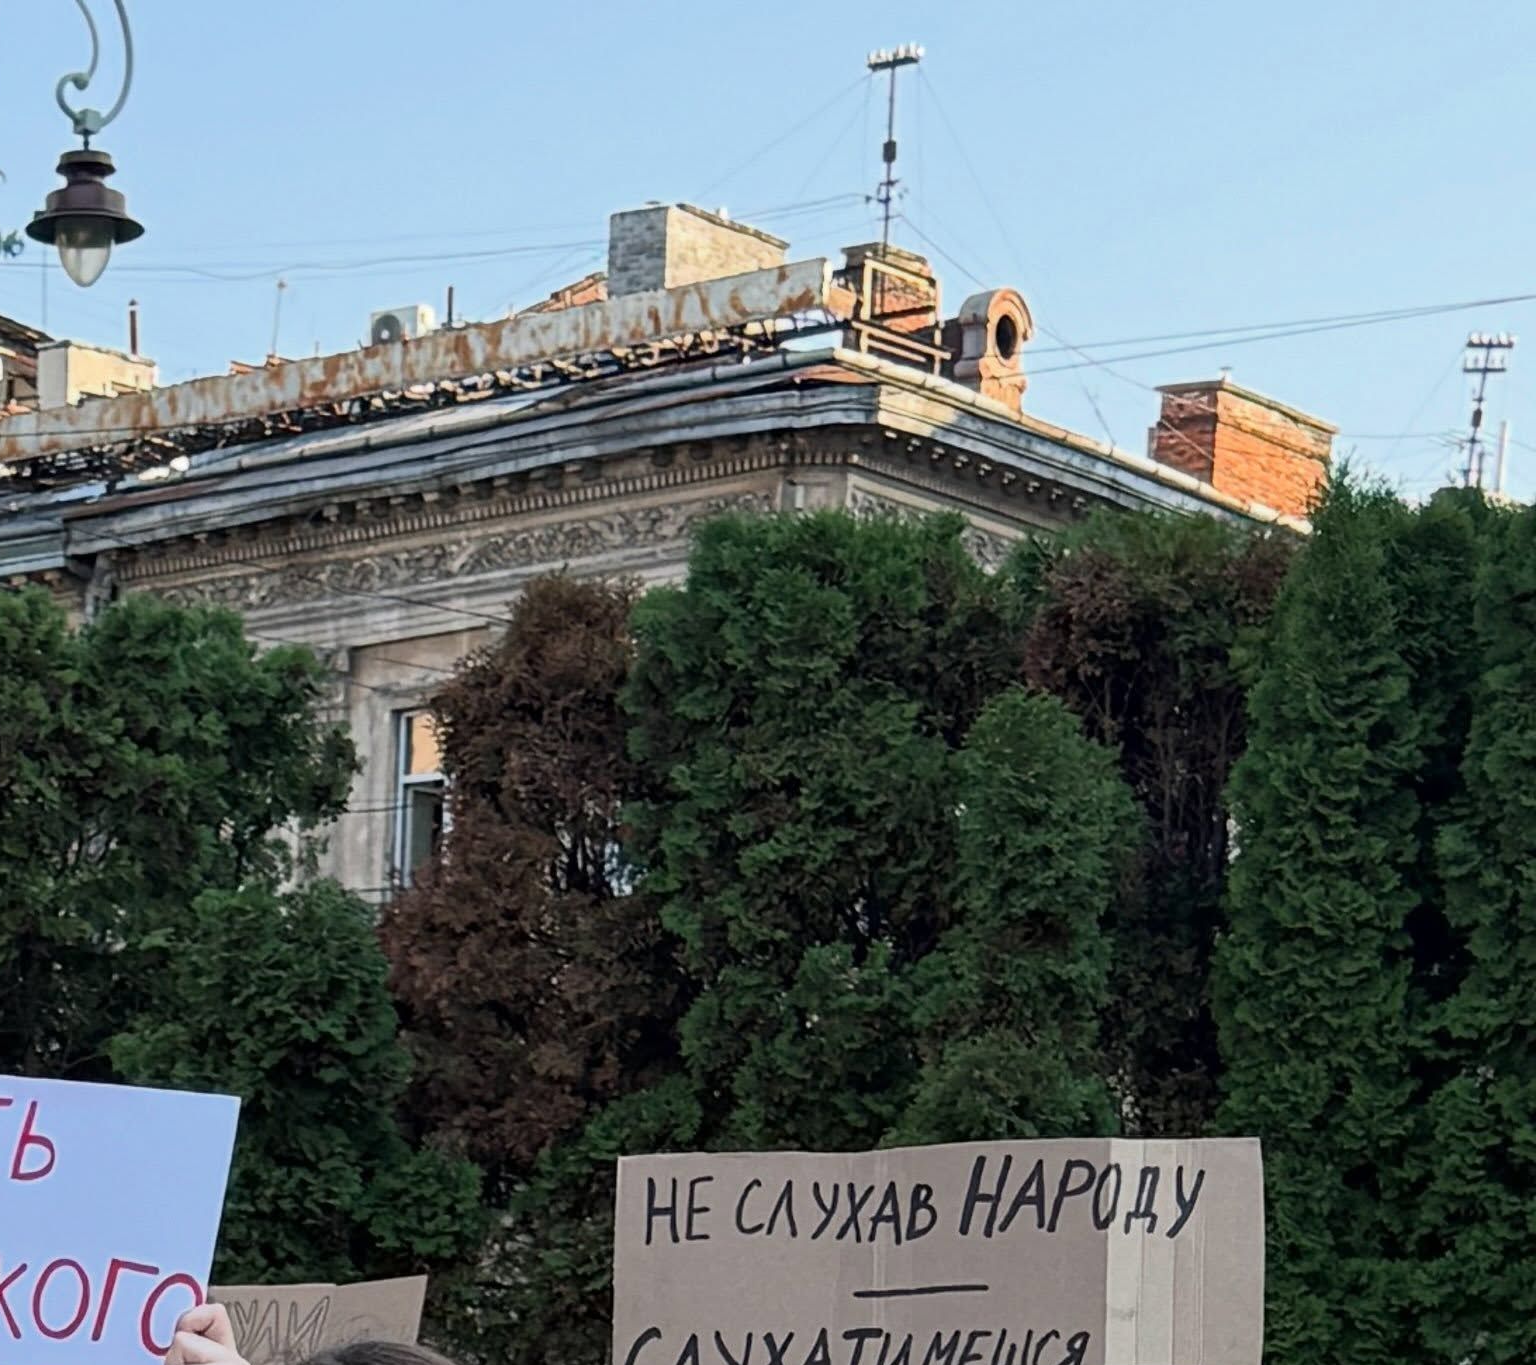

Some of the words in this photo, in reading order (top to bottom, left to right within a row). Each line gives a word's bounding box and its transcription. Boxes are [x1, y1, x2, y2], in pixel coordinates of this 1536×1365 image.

[645, 1176, 714, 1245] НЕ
[735, 1179, 937, 1245] СЛУХАВ
[958, 1155, 1208, 1240] НАРОДУ
